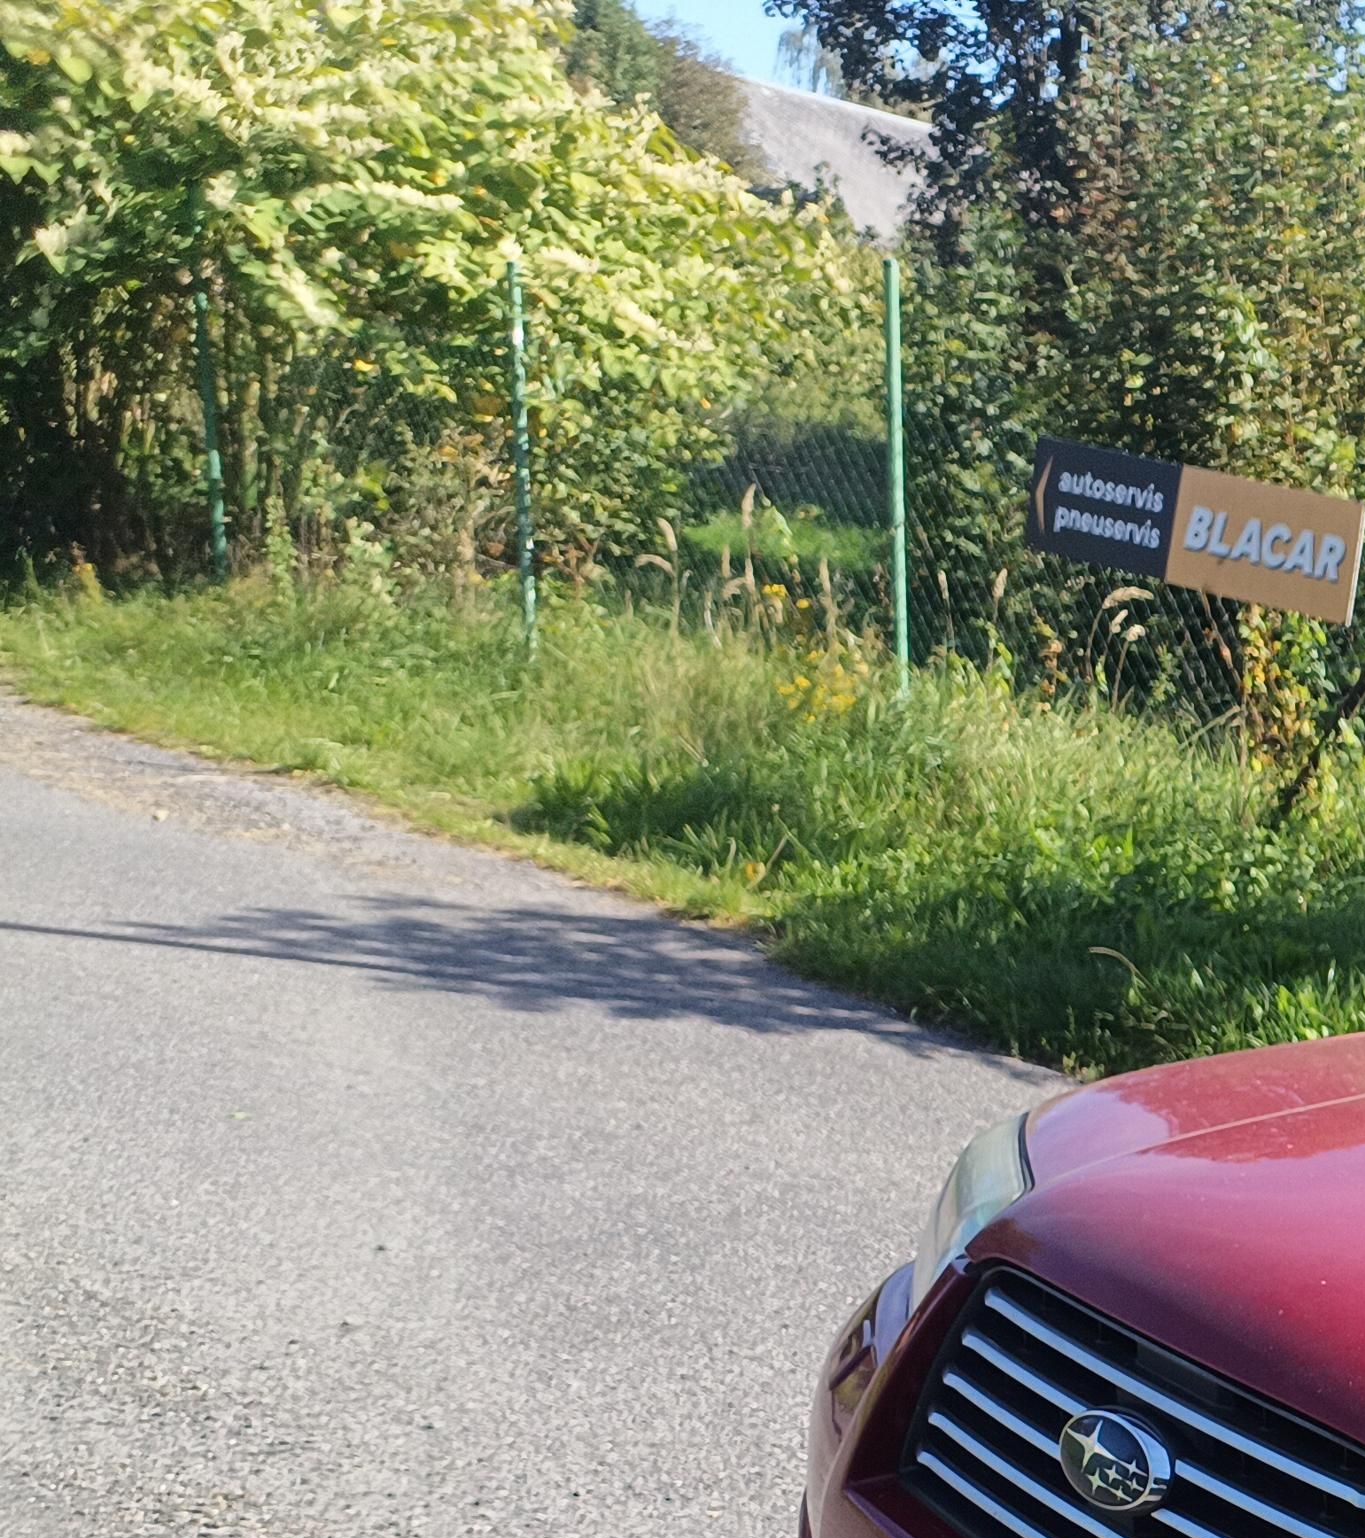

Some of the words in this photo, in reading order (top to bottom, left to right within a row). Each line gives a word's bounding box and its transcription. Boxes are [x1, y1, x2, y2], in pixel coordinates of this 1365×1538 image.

[1057, 470, 1165, 514] autoservis
[1053, 504, 1161, 550] pneuservis
[1182, 504, 1347, 582] BLACAR
